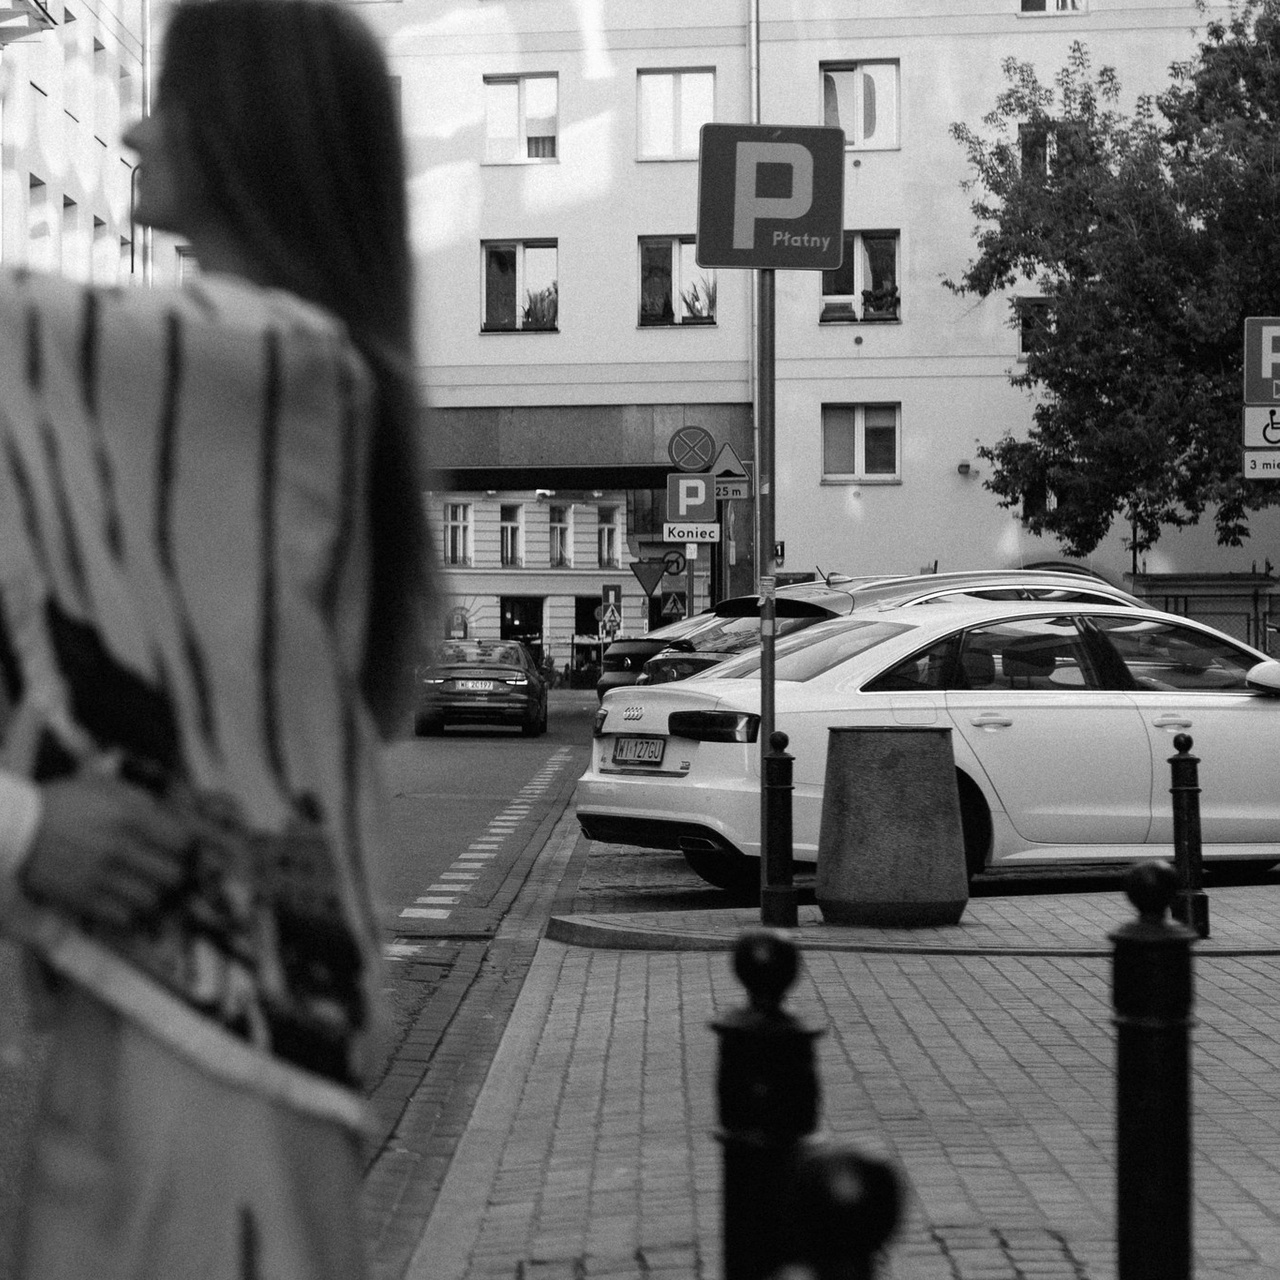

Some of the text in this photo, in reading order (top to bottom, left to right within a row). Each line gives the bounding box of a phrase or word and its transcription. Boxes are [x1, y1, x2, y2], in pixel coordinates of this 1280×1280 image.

[732, 141, 814, 249] P
[772, 231, 831, 252] Płatny
[1250, 459, 1256, 470] 3
[678, 479, 706, 516] P
[715, 486, 728, 496] 25
[668, 526, 716, 539] Koniec
[633, 740, 661, 759] 127GU
